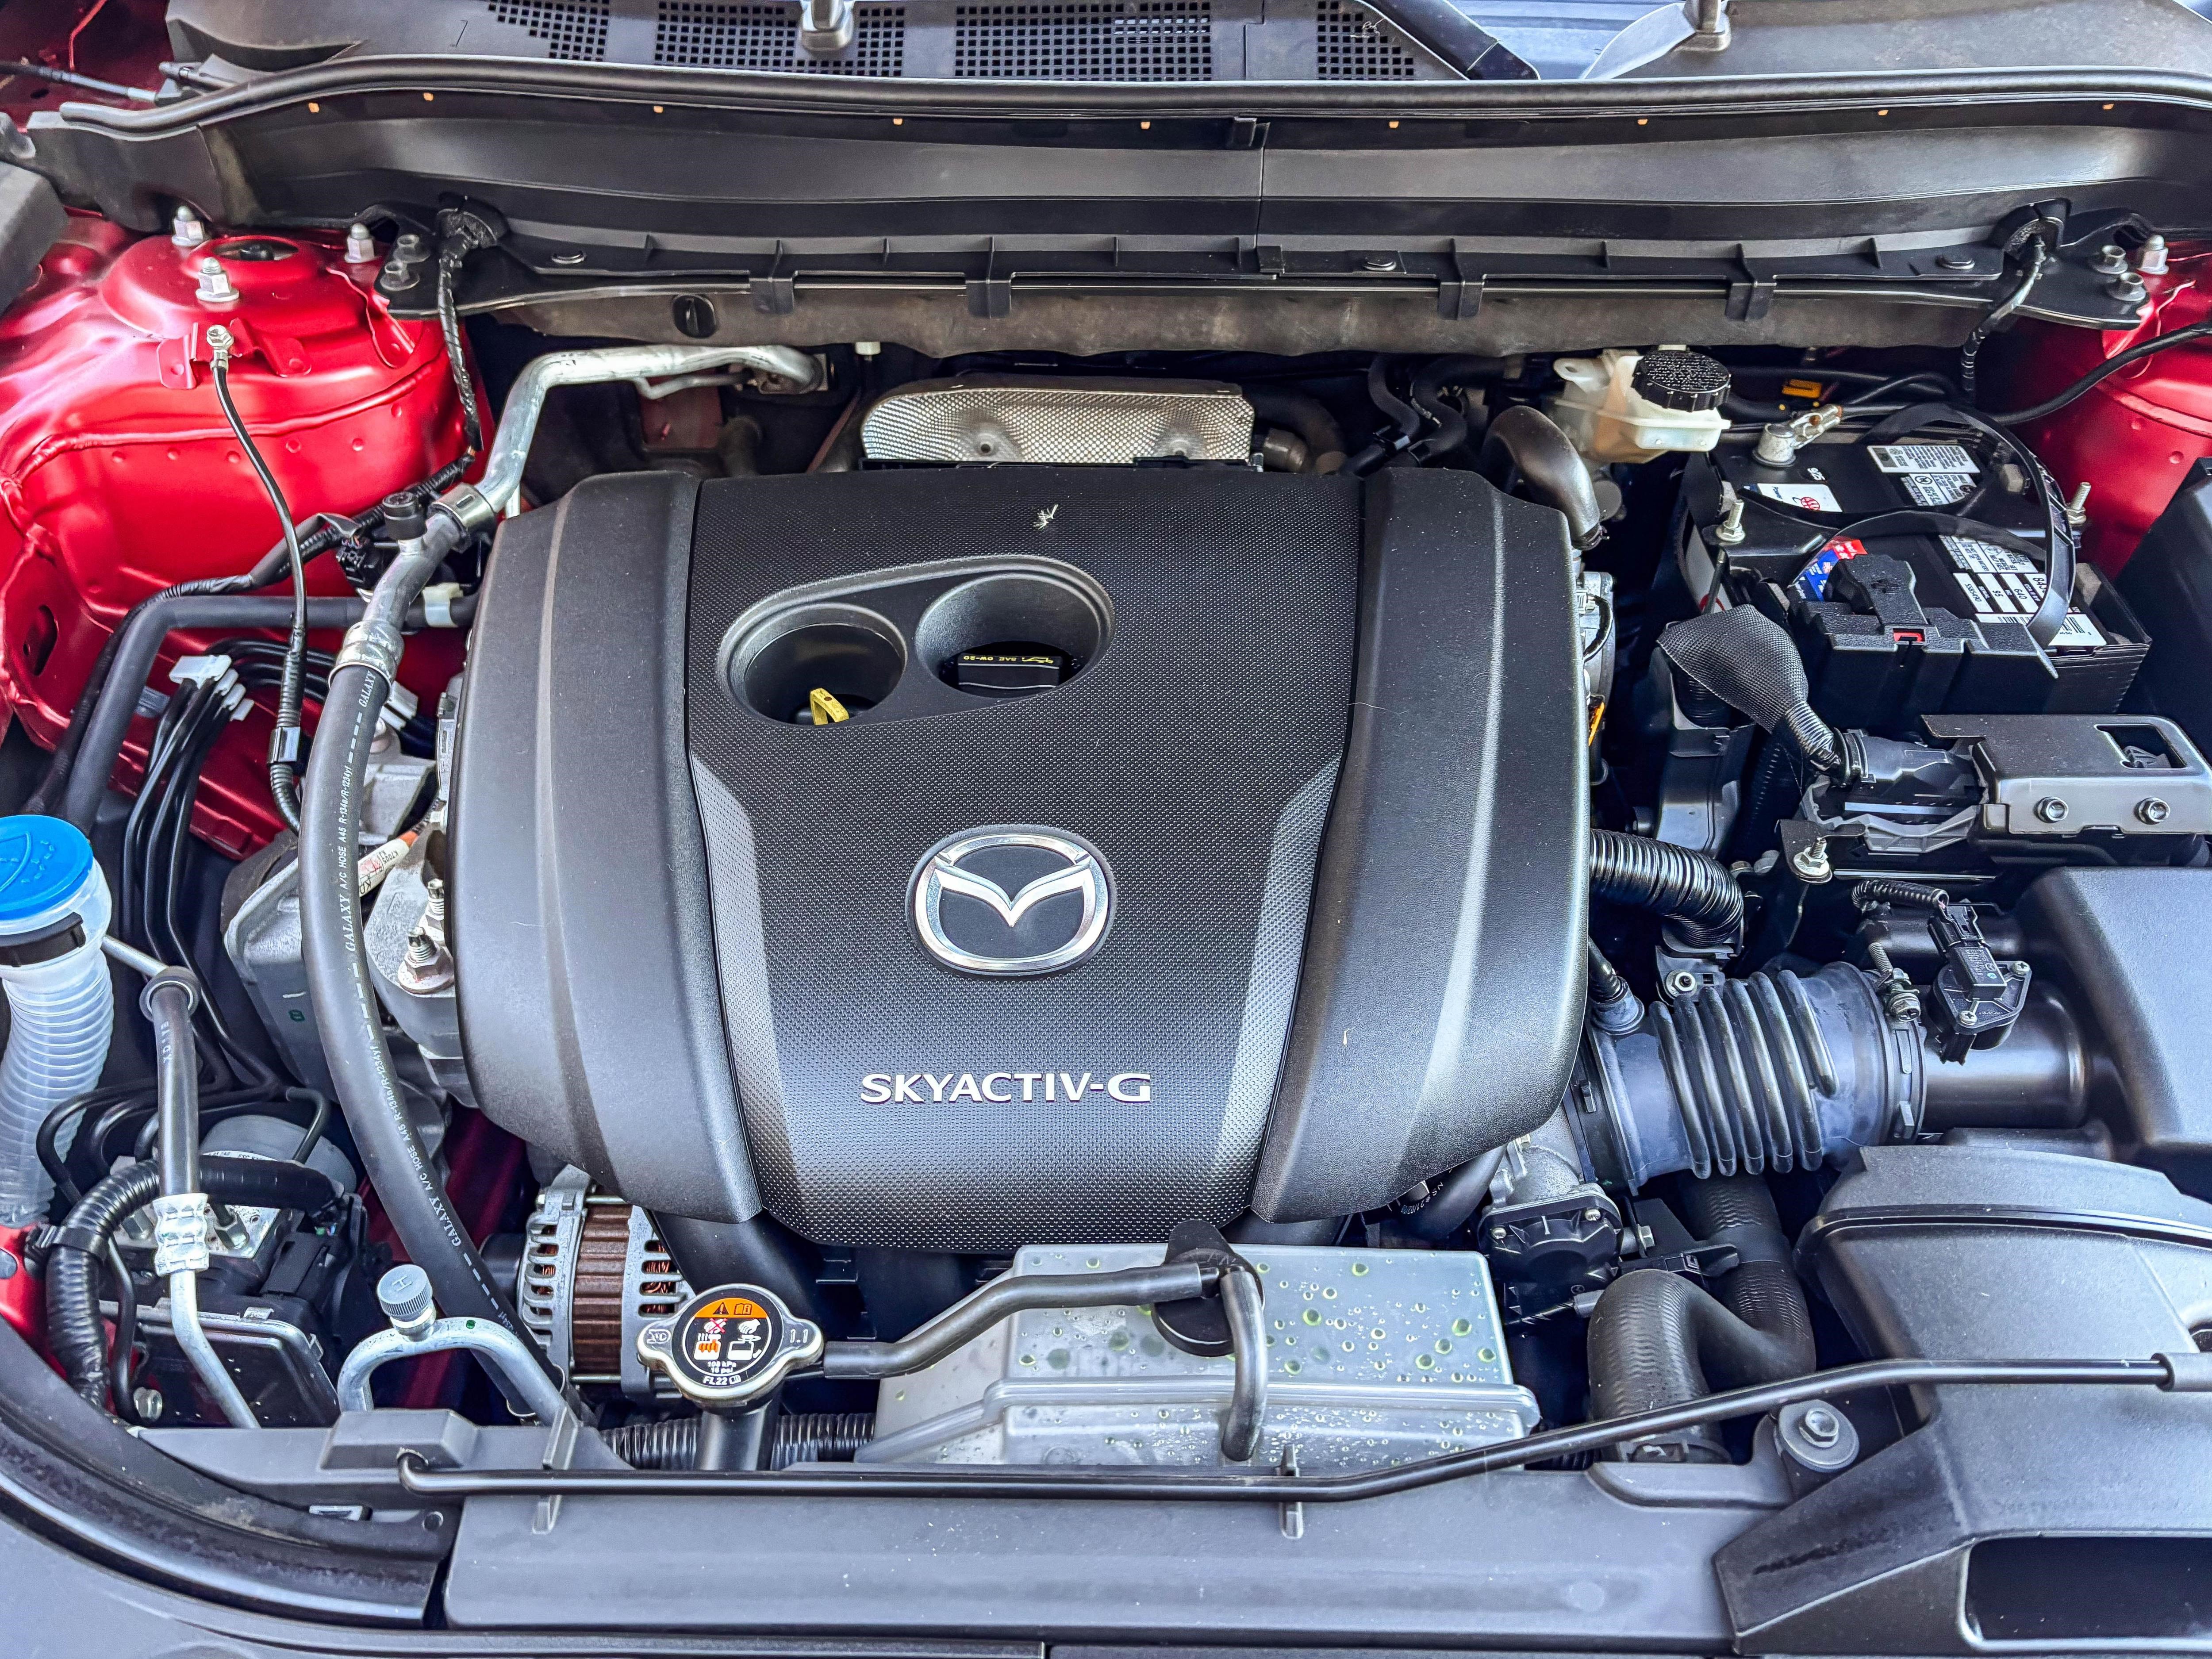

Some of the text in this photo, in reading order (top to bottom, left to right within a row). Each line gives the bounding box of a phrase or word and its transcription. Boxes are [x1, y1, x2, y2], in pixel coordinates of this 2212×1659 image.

[2014, 588, 2028, 599] 640
[359, 670, 377, 707] GALAXY
[338, 846, 347, 869] HOSE
[339, 894, 356, 952] GALAXY
[860, 1072, 1151, 1102] SKYACTIV-G
[407, 1145, 422, 1173] HOSE
[419, 1171, 434, 1191] A/C
[430, 1196, 461, 1247] GALAXY
[790, 1329, 809, 1343] 1.1
[703, 1375, 728, 1385] FL22
